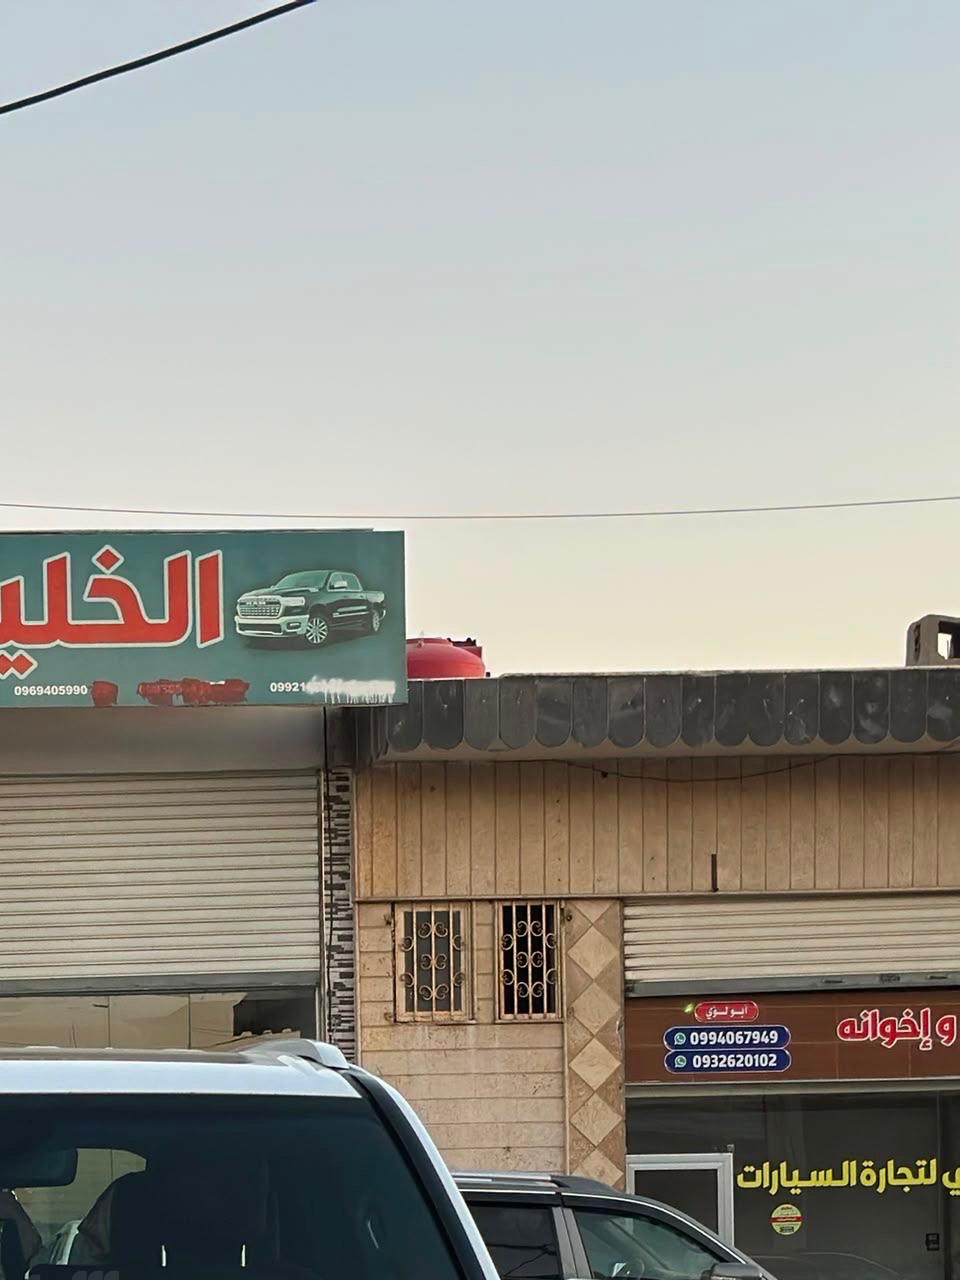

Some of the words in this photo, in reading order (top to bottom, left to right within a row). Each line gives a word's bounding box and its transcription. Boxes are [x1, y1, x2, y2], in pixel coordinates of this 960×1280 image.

[13, 684, 88, 697] 0969405990
[689, 1030, 779, 1046] 0994067949
[836, 1008, 932, 1050] إخوانه
[935, 1014, 957, 1046] و
[692, 1053, 778, 1069] 0932620102
[736, 1160, 857, 1195] السيارات
[859, 1158, 938, 1194] لتجارة
